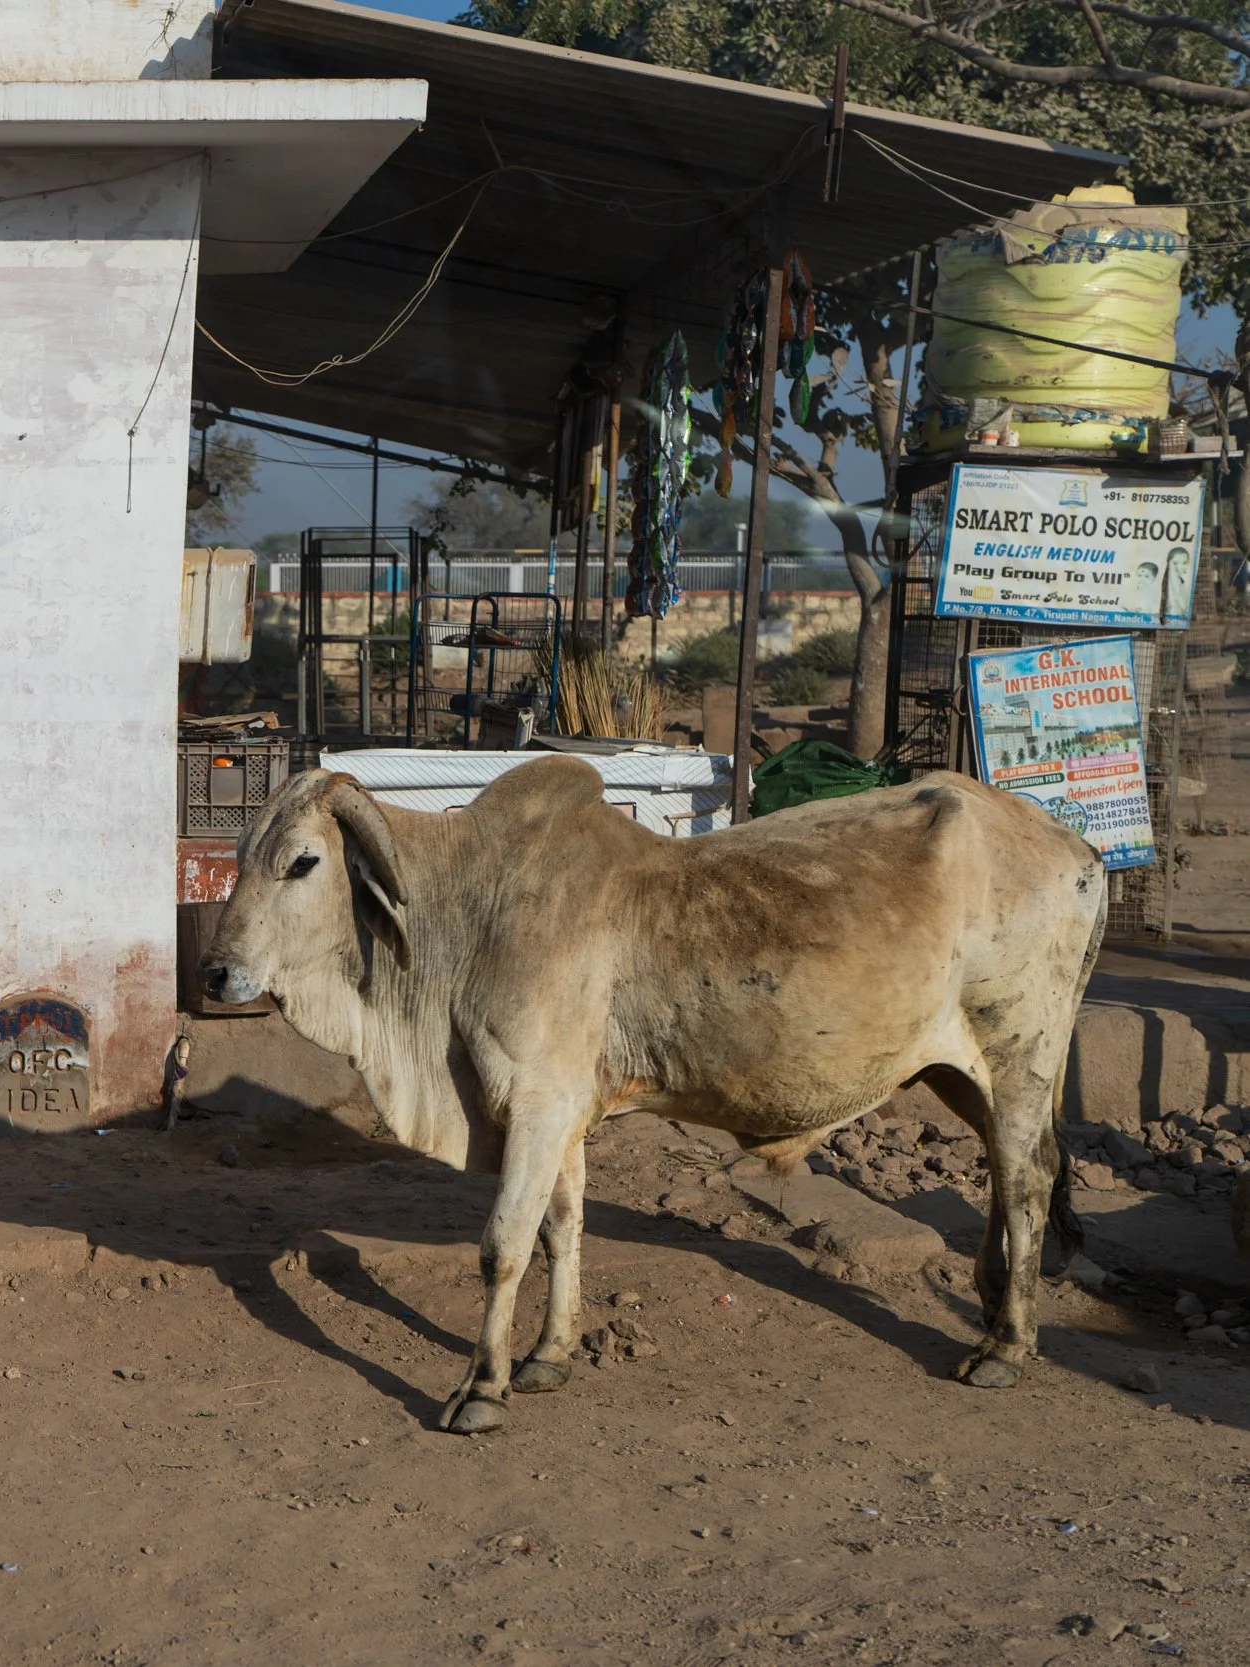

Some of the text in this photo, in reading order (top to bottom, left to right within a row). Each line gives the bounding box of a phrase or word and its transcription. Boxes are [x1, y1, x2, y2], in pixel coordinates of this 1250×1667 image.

[1131, 493, 1190, 504] 8107758353
[955, 508, 1194, 543] SMART POLO SCHOOL
[973, 542, 1116, 565] ENGLISH MEDIUM
[953, 563, 995, 580] Play
[1001, 566, 1057, 584] Group
[1064, 570, 1086, 583] To
[1000, 589, 1041, 600] Smart
[1043, 591, 1074, 603] Polo
[1078, 593, 1119, 605] School
[1043, 609, 1079, 621] Tirupati
[1038, 649, 1081, 670] G.K.
[1005, 664, 1130, 694] INTERNATIONAL
[1052, 684, 1133, 710] SCHOOL
[1001, 767, 1017, 777] PLAY
[1017, 765, 1039, 775] GROUP
[1073, 765, 1134, 779] AFFORDABLE FEES
[1010, 777, 1044, 787] ADMISSION
[1045, 774, 1062, 783] FEES
[1066, 778, 1143, 801] Admission Open
[1086, 796, 1147, 812] 9887800055
[1087, 806, 1148, 822] 9414827845
[1089, 816, 1149, 832] 7031900055
[7, 1088, 81, 1114] IDEA
